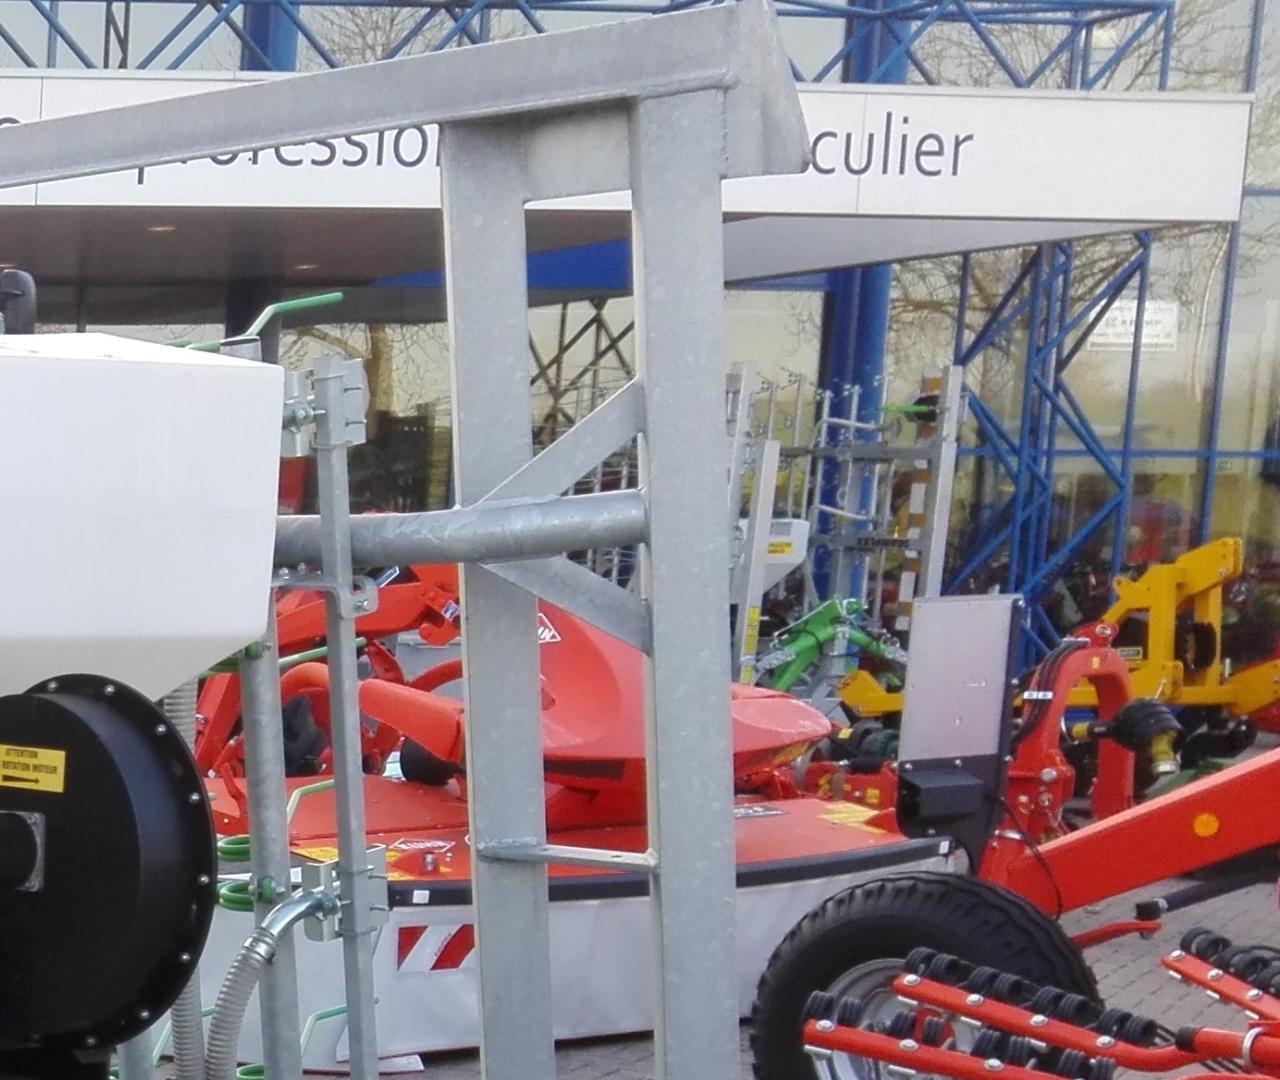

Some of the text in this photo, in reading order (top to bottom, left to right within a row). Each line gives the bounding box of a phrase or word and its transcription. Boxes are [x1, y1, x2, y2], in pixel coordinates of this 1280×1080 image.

[810, 110, 975, 177] culier
[5, 748, 39, 759] ATTENTION
[2, 760, 31, 772] ROTATION
